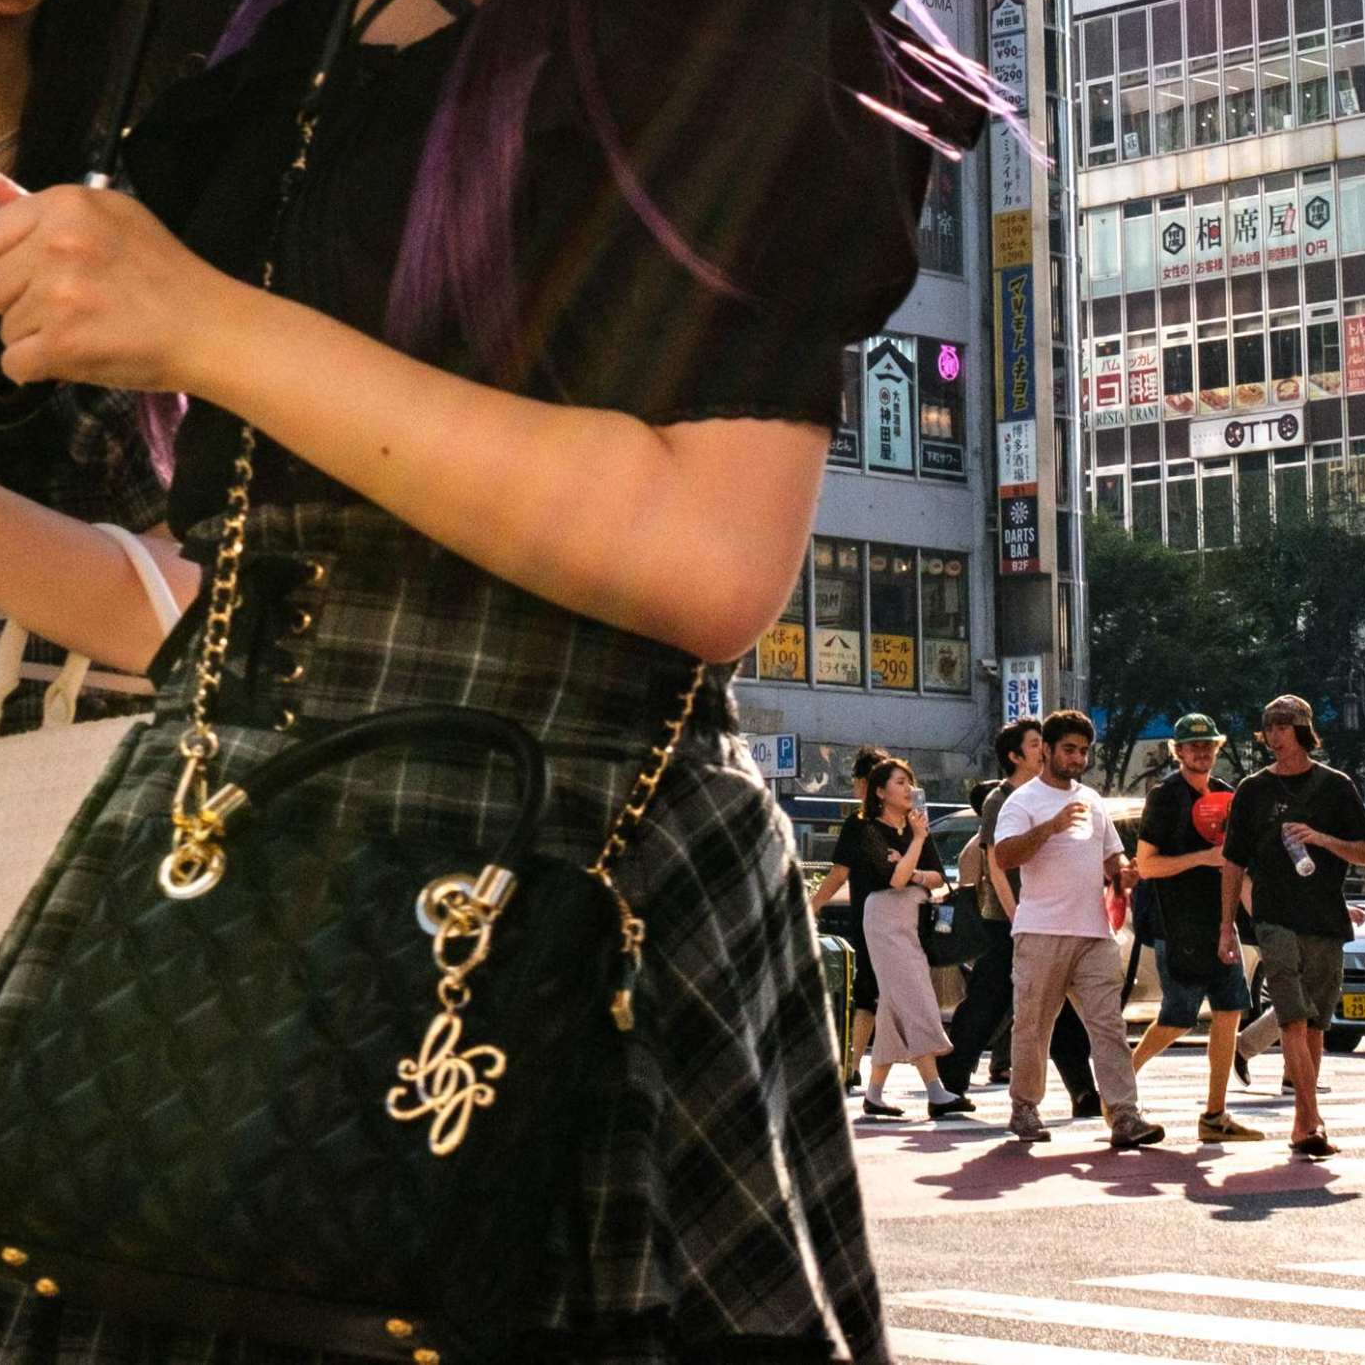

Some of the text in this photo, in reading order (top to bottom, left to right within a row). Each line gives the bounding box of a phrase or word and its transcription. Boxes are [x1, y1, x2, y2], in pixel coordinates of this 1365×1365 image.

[1004, 527, 1036, 544] DARTS
[1010, 543, 1029, 559] BAR
[1028, 678, 1039, 715] NEW
[781, 738, 791, 758] P
